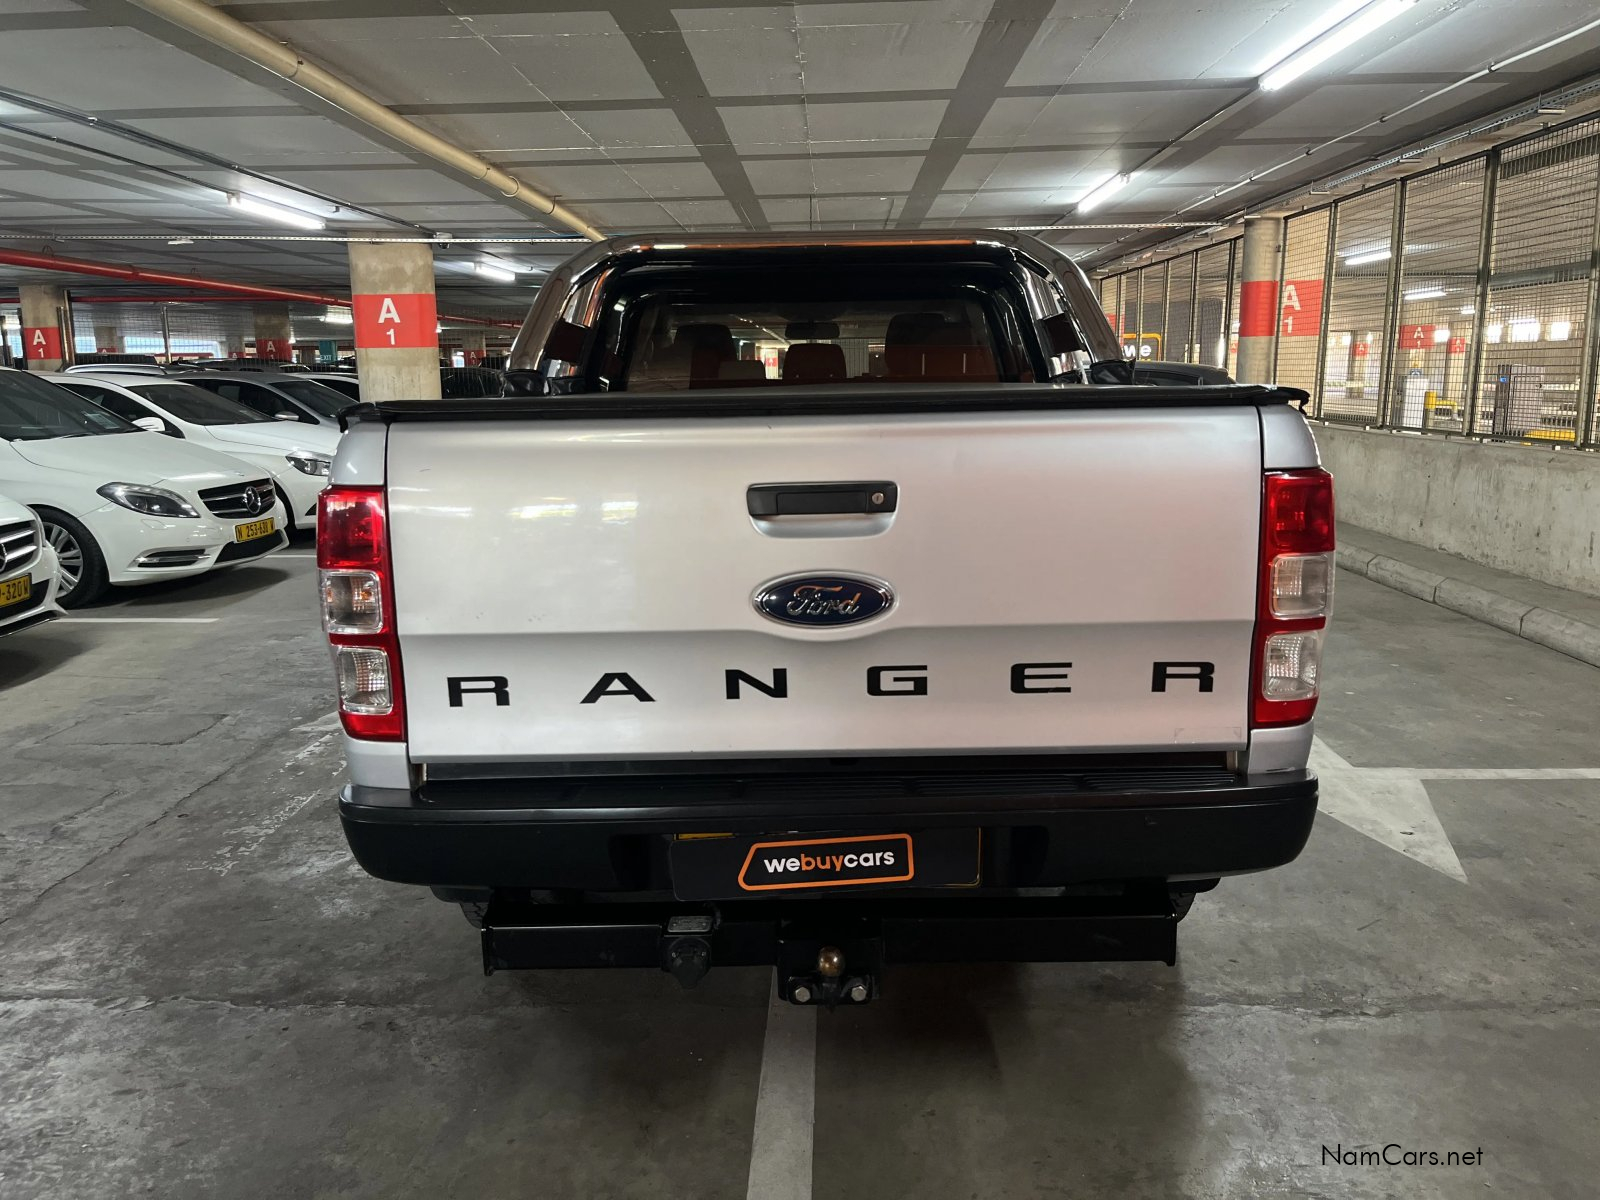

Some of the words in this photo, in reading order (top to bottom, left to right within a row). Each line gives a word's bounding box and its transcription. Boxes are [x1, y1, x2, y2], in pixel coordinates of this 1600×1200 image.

[1281, 284, 1301, 311] A
[378, 298, 401, 323] A
[1284, 316, 1293, 334] 1
[1413, 326, 1424, 339] A
[33, 329, 46, 345] A
[386, 328, 395, 345] 1
[38, 348, 44, 358] 1
[266, 340, 276, 353] A
[470, 351, 476, 359] A
[237, 526, 243, 539] N
[786, 585, 861, 616] Ford
[447, 661, 1215, 706] RANGER
[764, 851, 895, 874] webuycars
